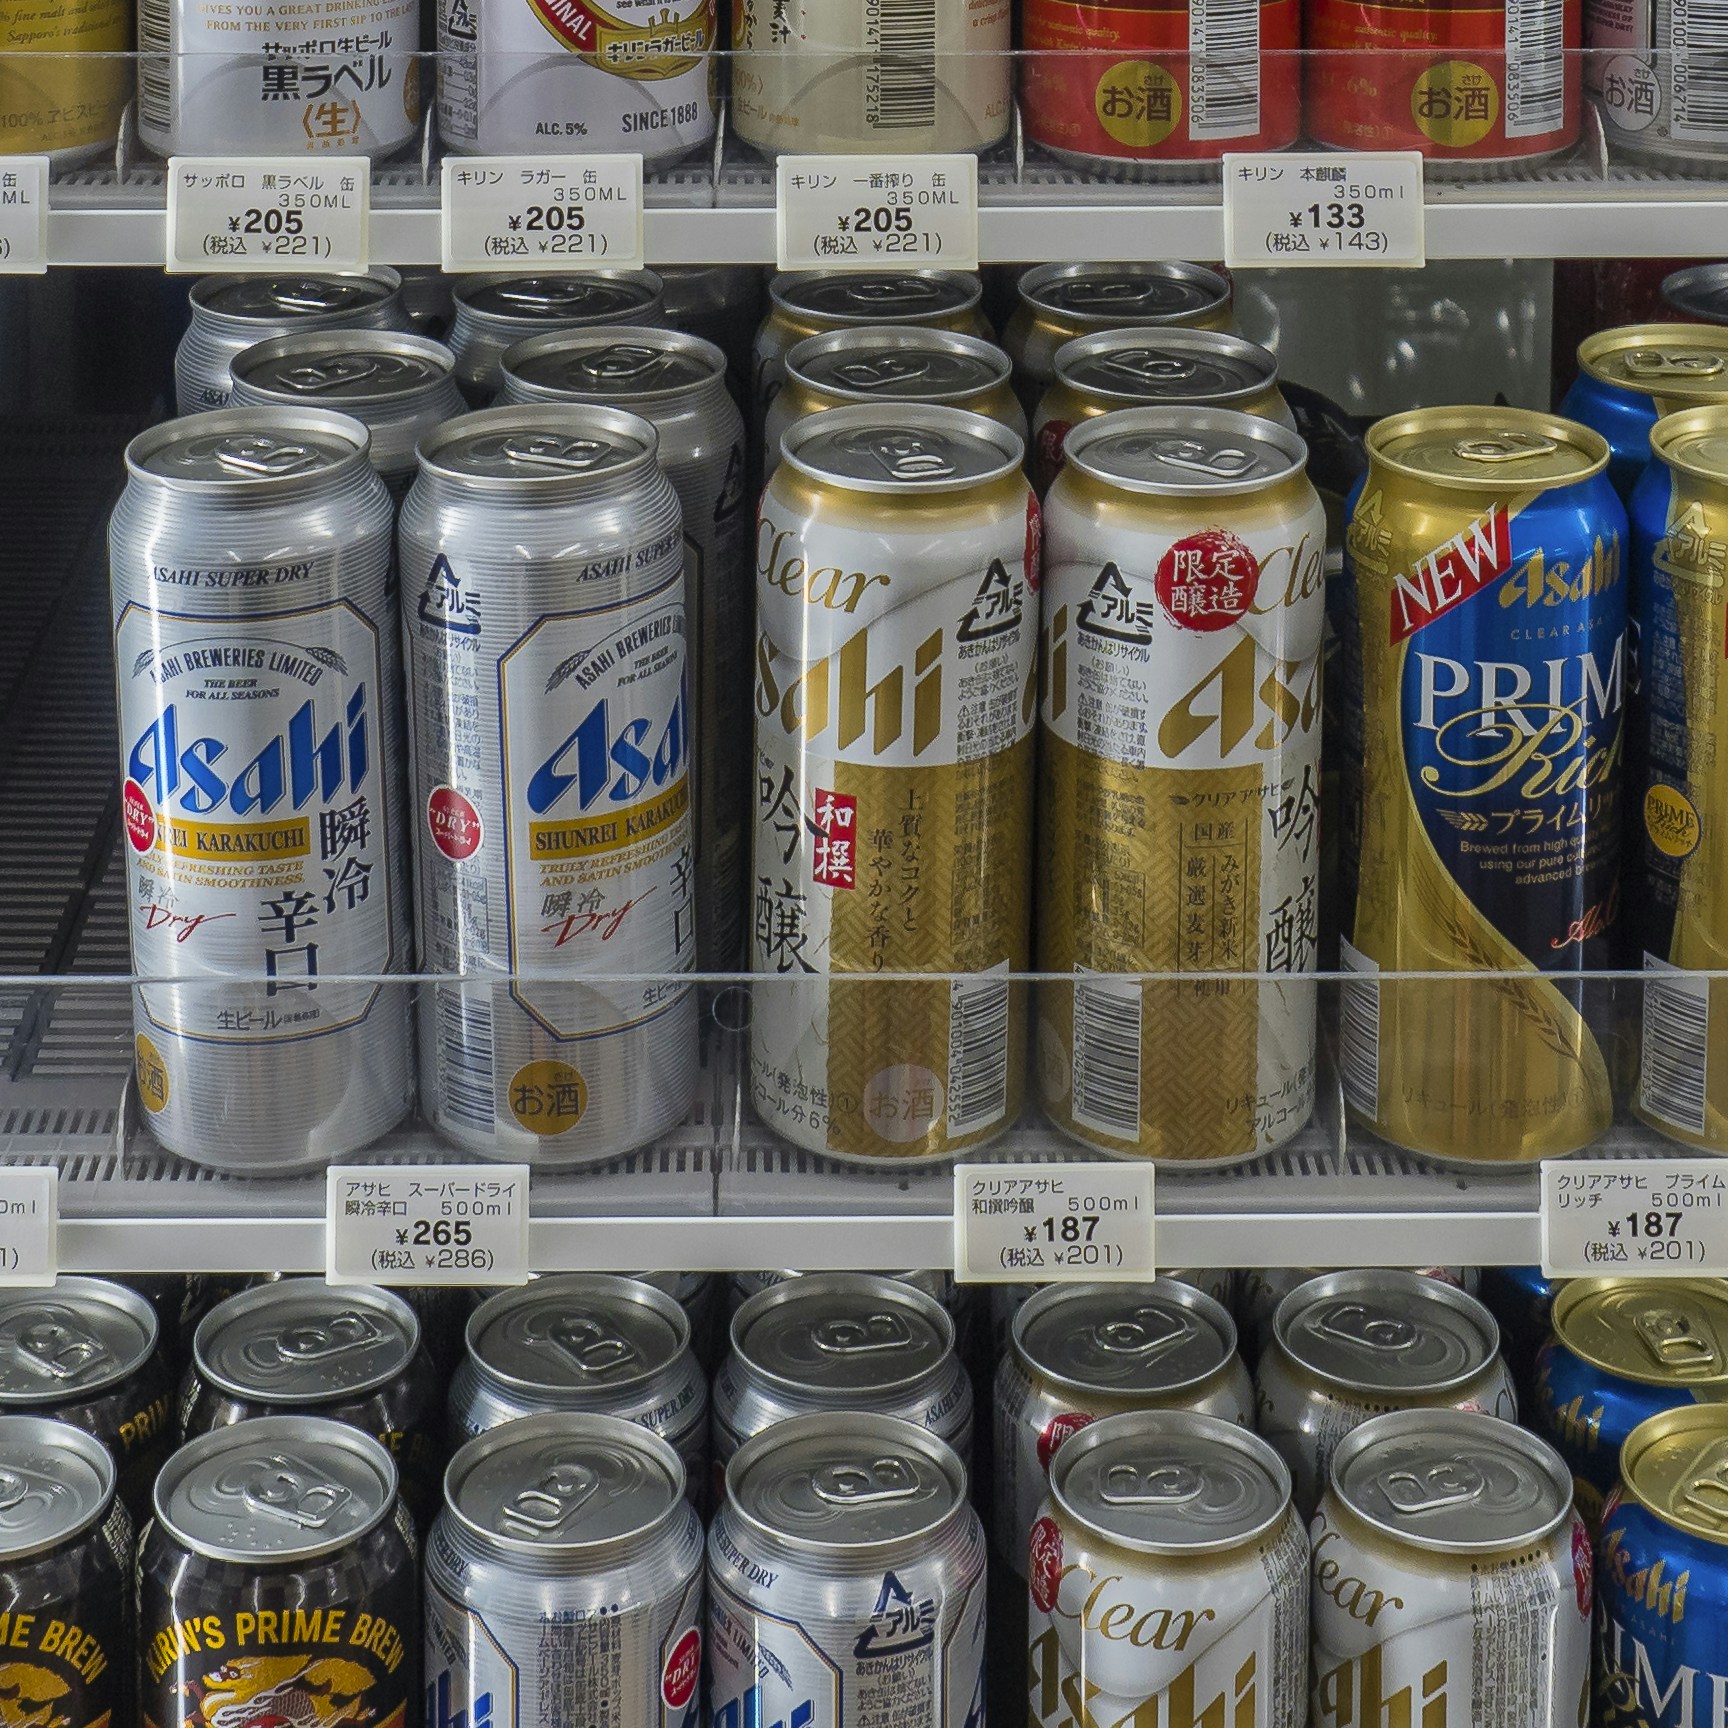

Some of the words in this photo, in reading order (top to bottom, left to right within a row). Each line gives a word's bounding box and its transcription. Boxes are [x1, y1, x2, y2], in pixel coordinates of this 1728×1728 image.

[606, 30, 706, 62] キリンラガービール
[260, 56, 392, 102] 黒ラベル
[622, 110, 666, 134] SINCE
[670, 104, 698, 128] 1888
[1102, 90, 1172, 122] お酒
[1418, 90, 1490, 122] お酒
[278, 193, 351, 209] 350ML
[886, 190, 960, 206] 350ML
[227, 208, 304, 235] ¥205
[508, 205, 585, 232] ¥205
[837, 206, 913, 233] ¥205
[1288, 202, 1366, 230] ¥133
[1265, 231, 1311, 254] (税込
[1318, 231, 1388, 254] ¥143)
[205, 566, 270, 586] SUPER
[274, 562, 314, 584] DRY
[1172, 548, 1242, 578] 限定
[1392, 502, 1502, 630] NEW
[1171, 582, 1244, 618] 醸造
[186, 648, 266, 672] BREWERIES
[270, 652, 324, 688] LIMITED
[128, 682, 372, 818] Asahi
[196, 832, 306, 862] KARAKUCHI
[536, 826, 618, 860] SHUNREI
[140, 904, 238, 944] Dry
[542, 886, 656, 948] Dry
[512, 1078, 580, 1118] お酒
[346, 1181, 391, 1198] アサヒ
[408, 1181, 516, 1198] スーパードライ
[972, 1178, 1065, 1196] クリアアサヒ
[1557, 1173, 1648, 1191] クリアアサヒ
[344, 1199, 408, 1217] 瞬冷辛口
[440, 1200, 511, 1216] 500ml
[1558, 1192, 1603, 1209] リッチ
[1651, 1192, 1721, 1208] 500ml
[395, 1219, 473, 1247] ¥265
[1023, 1215, 1100, 1243] ¥187
[1607, 1211, 1684, 1238] ¥187
[1056, 1562, 1216, 1654] Clear
[40, 1612, 108, 1684] BREW
[242, 1610, 348, 1646] PRIME
[350, 1612, 406, 1676] BREW
